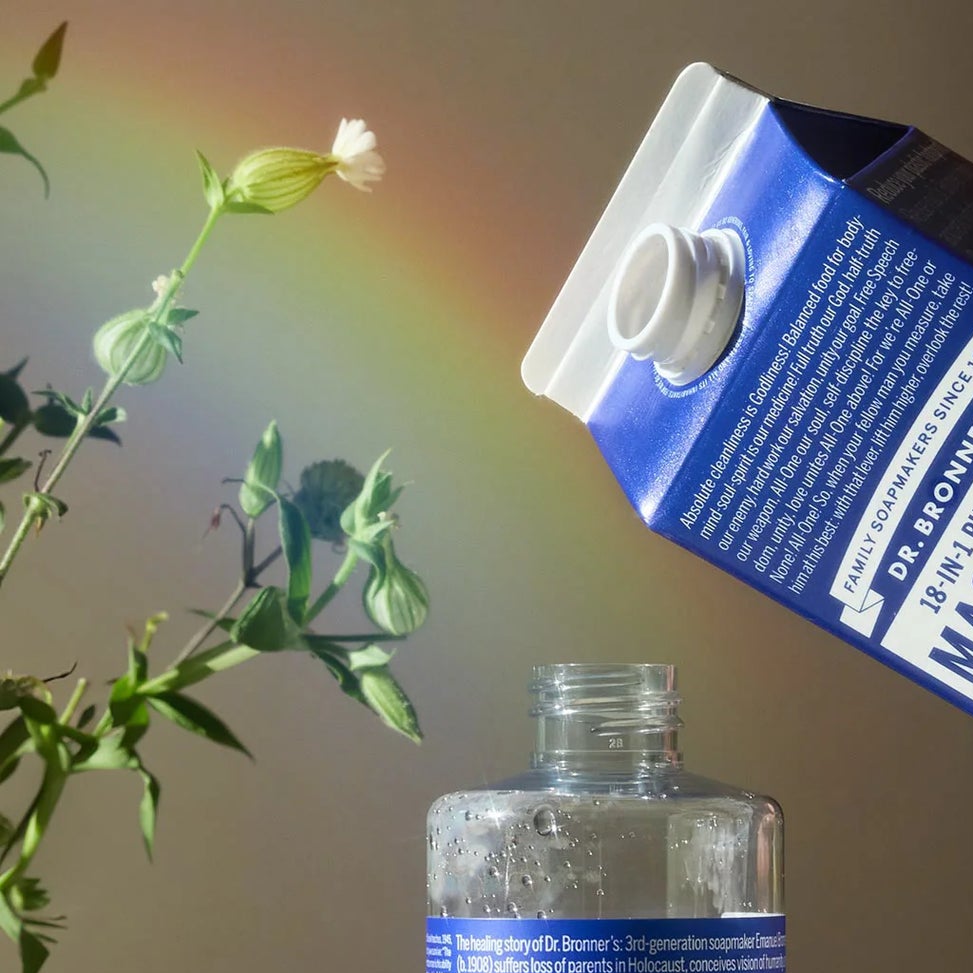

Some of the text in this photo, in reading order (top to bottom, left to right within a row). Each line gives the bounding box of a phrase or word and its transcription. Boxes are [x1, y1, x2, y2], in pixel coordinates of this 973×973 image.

[679, 215, 864, 530] Absolute cleanliness is Godliness! Balanced food for body-
[700, 228, 881, 540] mind-soul-spirit is our medicine! Full truth our God, half-truth
[843, 533, 876, 594] FAMILY
[870, 422, 938, 532] SOAPMAKERS
[933, 370, 973, 420] SINCE
[887, 541, 924, 581] DR.
[919, 540, 973, 614] 18-IN-1
[455, 933, 755, 956] The healing story of Dr. Bronner's: 3rd-generation soapmaker
[493, 956, 530, 973] suffers
[530, 956, 553, 973] loss
[554, 957, 566, 973] of
[615, 957, 626, 973] in
[628, 956, 688, 973] Holocaust,
[689, 956, 736, 972] conceives
[758, 953, 766, 970] of
